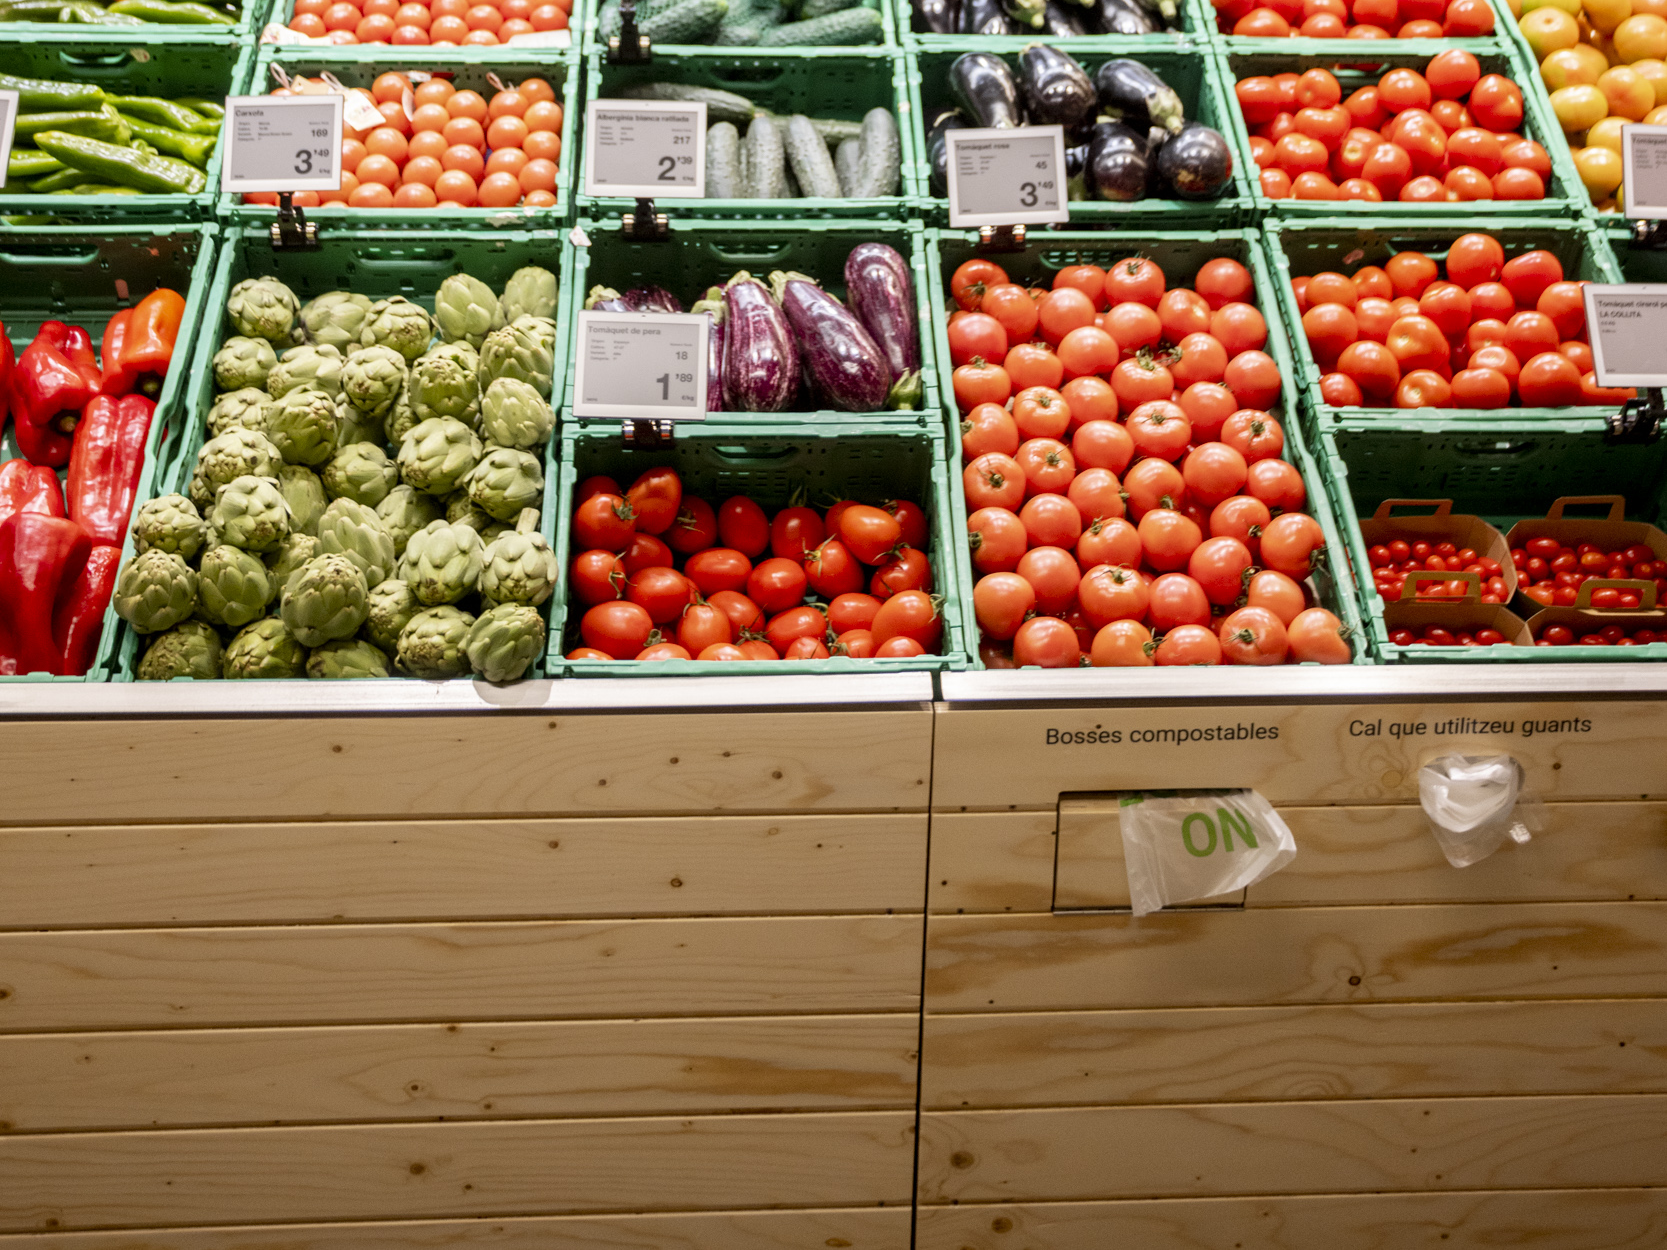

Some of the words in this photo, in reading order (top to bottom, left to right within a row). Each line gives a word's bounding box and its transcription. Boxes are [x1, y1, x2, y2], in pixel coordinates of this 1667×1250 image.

[311, 128, 328, 137] 169
[673, 136, 691, 144] 217
[1035, 161, 1047, 170] 45
[588, 325, 629, 335] Tomàquet
[630, 326, 641, 335] de
[642, 328, 661, 336] pera
[675, 350, 688, 360] 18
[1349, 718, 1382, 737] Cal
[1389, 720, 1427, 740] que
[1434, 717, 1514, 735] utilitzeu
[1522, 718, 1592, 737] guants
[1046, 728, 1122, 745] Bosses
[1130, 723, 1279, 746] compostables
